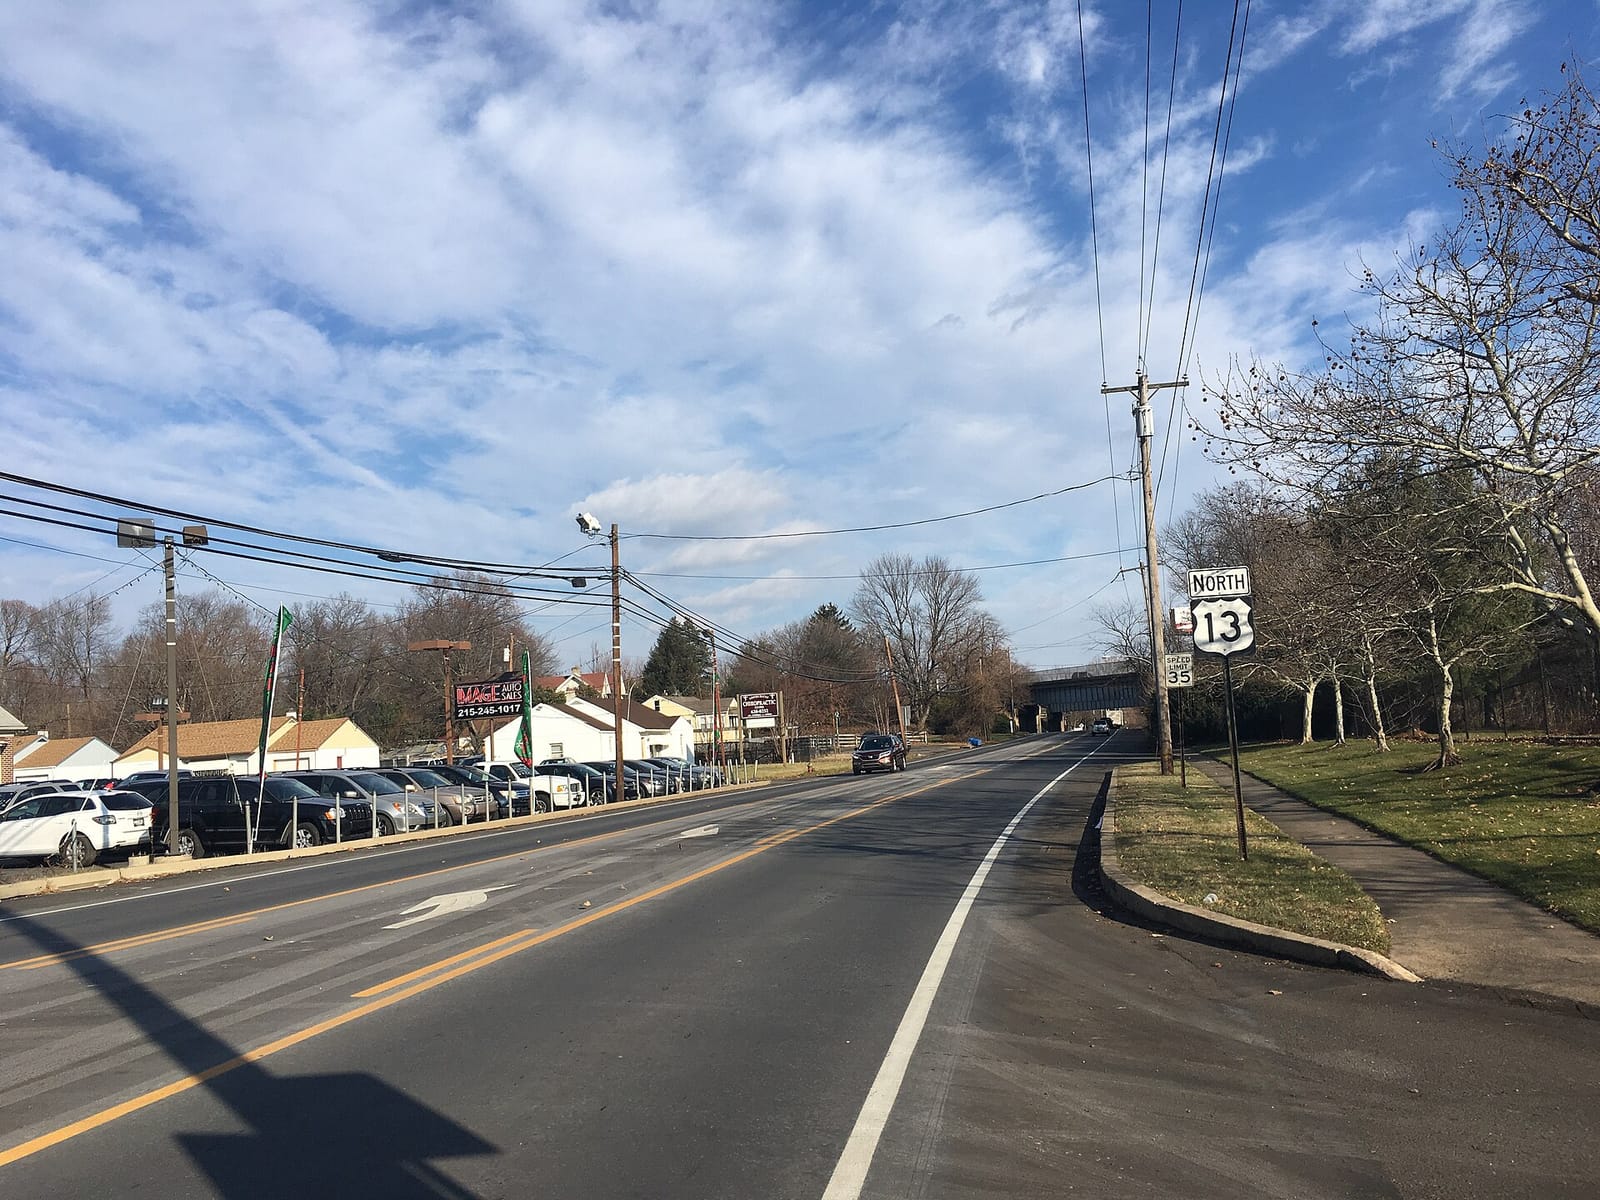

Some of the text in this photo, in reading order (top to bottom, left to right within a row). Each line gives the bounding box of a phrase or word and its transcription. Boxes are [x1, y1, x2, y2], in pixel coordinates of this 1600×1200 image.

[1193, 574, 1245, 592] NORTH
[1204, 611, 1241, 643] 13
[1168, 671, 1191, 683] 35
[502, 683, 522, 692] AUTO
[502, 692, 522, 700] SALES
[458, 704, 521, 717] 215-245-1017
